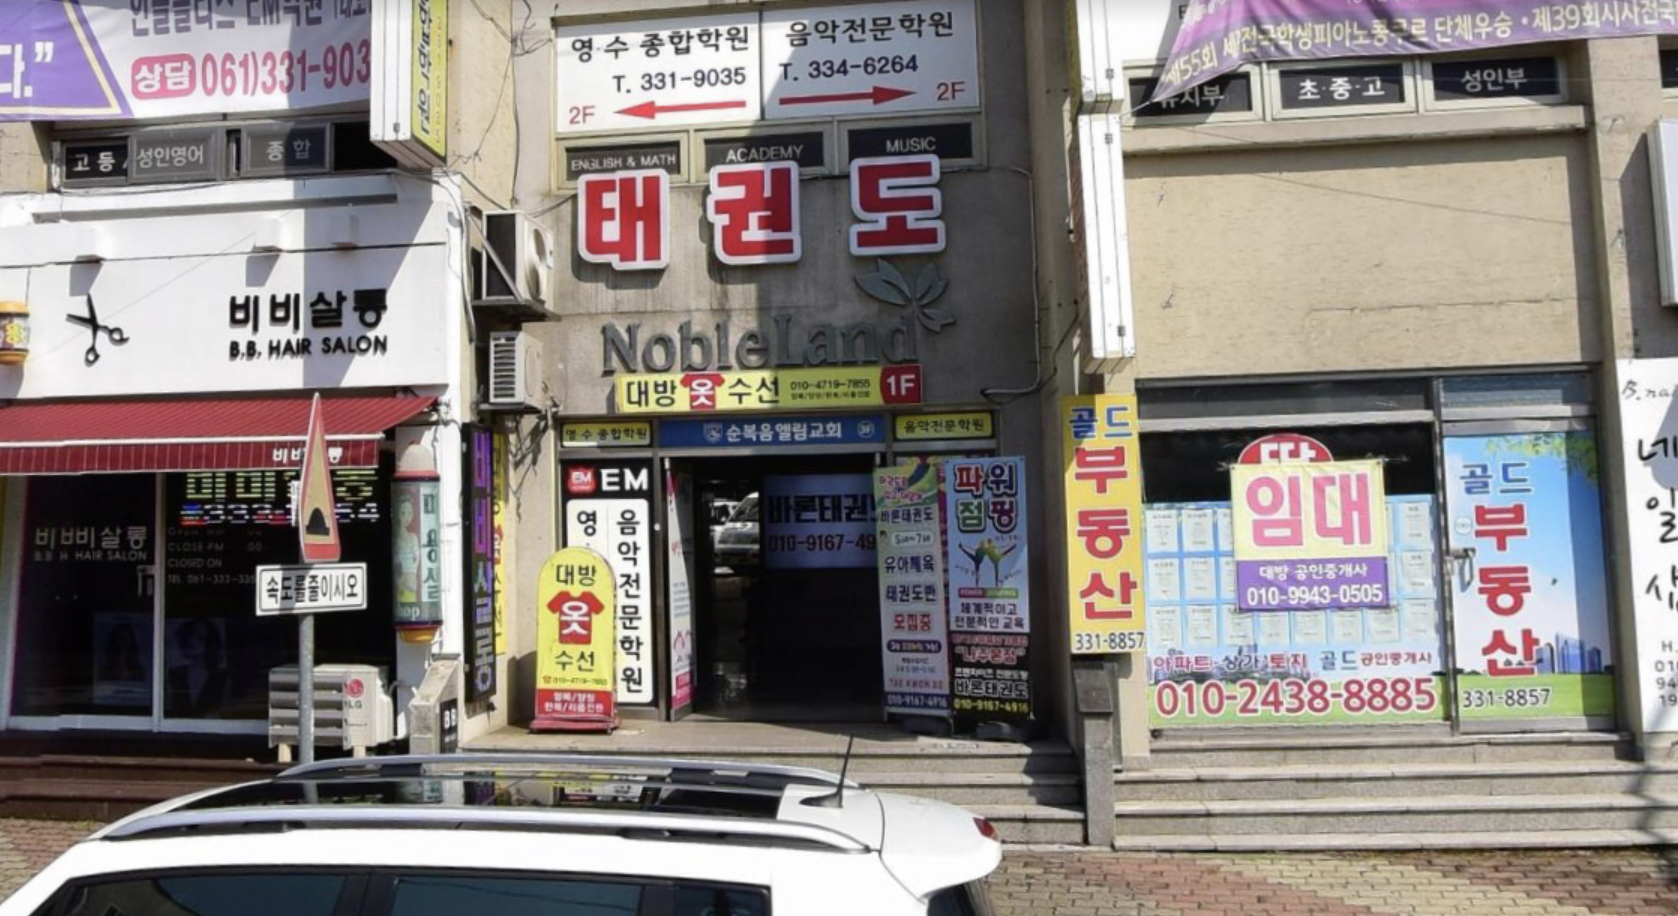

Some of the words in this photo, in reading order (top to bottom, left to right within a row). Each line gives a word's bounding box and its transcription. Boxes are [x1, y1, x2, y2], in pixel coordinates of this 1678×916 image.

[785, 11, 954, 48] 음악전문학원
[1434, 13, 1514, 42] 단체우승
[639, 26, 749, 58] 종합학원
[135, 60, 192, 93] 상담
[202, 39, 370, 97] 061)331-903
[780, 62, 798, 82] T.
[809, 55, 918, 79] 334-6264
[613, 75, 631, 94] T.
[640, 67, 747, 91] 331-9035
[1461, 67, 1529, 93] 성인부
[936, 83, 965, 101] 2F
[569, 107, 597, 125] 2F
[726, 144, 803, 162] ACADEMY
[886, 136, 937, 153] MUSIC
[137, 145, 205, 169] 성인영어
[571, 157, 622, 171] ENGLISH
[627, 157, 637, 168] &
[641, 154, 677, 167] MATH
[580, 157, 944, 267] 태권도
[230, 288, 387, 334] 비비살롱
[269, 338, 312, 360] HAIR
[322, 335, 388, 356] SALON
[627, 379, 677, 407] 대방
[689, 378, 714, 407] 옷
[728, 376, 779, 405] 수선
[790, 378, 871, 391] 010-4719-7855
[887, 374, 916, 397] 1F
[726, 421, 843, 443] 순복음엘림교회
[904, 418, 985, 434] 음악전문학원
[1069, 407, 1133, 439] 골드
[272, 446, 343, 464] 비비롱
[601, 468, 649, 492] EM
[955, 463, 1015, 495] 파워
[1460, 462, 1532, 495] 골드
[879, 506, 934, 524] 바른태권도
[957, 499, 1016, 531] 점핑
[1246, 473, 1372, 547] 임대
[768, 533, 876, 552] 010-9167-49
[1075, 446, 1137, 619] 부동산
[422, 493, 439, 600] 미용실
[884, 554, 935, 573] 유아체육
[1259, 564, 1289, 581] 대방
[1294, 562, 1368, 580] 공인중개사
[186, 574, 256, 584] 061-333-335
[556, 564, 597, 587] 대방
[266, 573, 359, 604] 속도를줄이시오
[886, 584, 937, 603] 태권도반
[1246, 584, 1383, 606] 010-9943-0505
[1475, 503, 1539, 677] 부동산
[616, 508, 643, 694] 음악전문학원
[961, 602, 1018, 615] 체계적이고
[560, 601, 590, 635] 옷
[894, 613, 931, 632] 모집중
[1003, 616, 1025, 630] 교육
[1076, 632, 1145, 651] 331-8857
[554, 650, 596, 672] 수선
[1154, 653, 1211, 673] 아파트
[1222, 654, 1259, 671] 상가
[1269, 652, 1308, 670] 토지
[1319, 650, 1359, 671] 골드
[1360, 651, 1432, 668] 공인중개사
[954, 678, 1030, 700] 바른태권도
[1155, 676, 1436, 716] 010-2438-8885
[1462, 689, 1551, 708] 331-8857
[349, 700, 364, 709] LG
